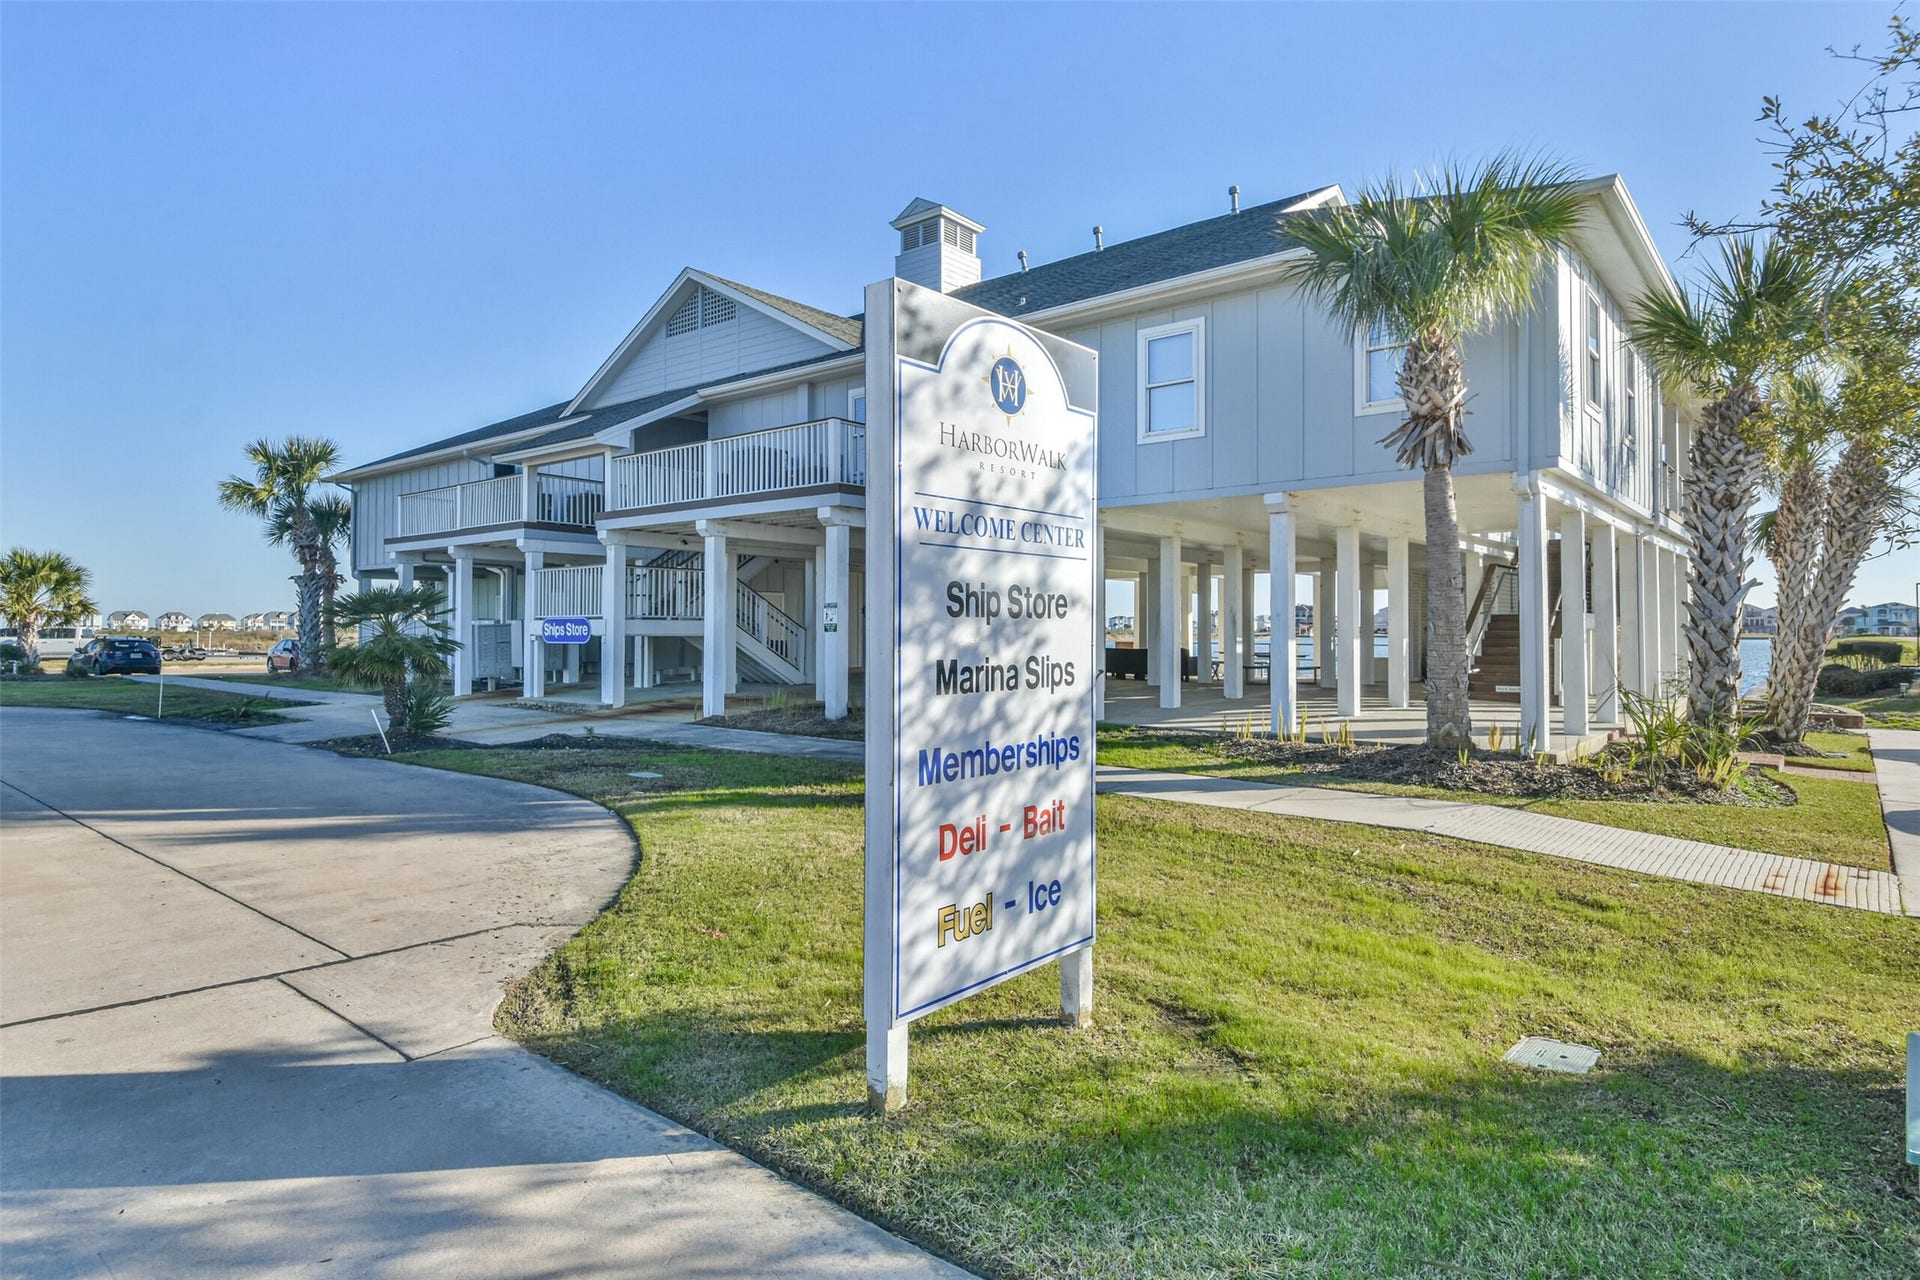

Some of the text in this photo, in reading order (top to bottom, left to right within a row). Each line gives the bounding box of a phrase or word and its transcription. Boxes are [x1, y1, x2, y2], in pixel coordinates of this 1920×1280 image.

[979, 461, 1036, 480] RESORT
[913, 506, 1085, 548] WELCOME CENTER
[946, 580, 1068, 625] Ship Store
[544, 622, 589, 638] Ships Store
[936, 655, 1075, 696] Marina Slips
[918, 732, 1080, 787] Memberships
[938, 814, 986, 862] Deli
[1023, 800, 1066, 840] Bait
[937, 891, 993, 949] Fuel
[1028, 879, 1062, 914] Ice
